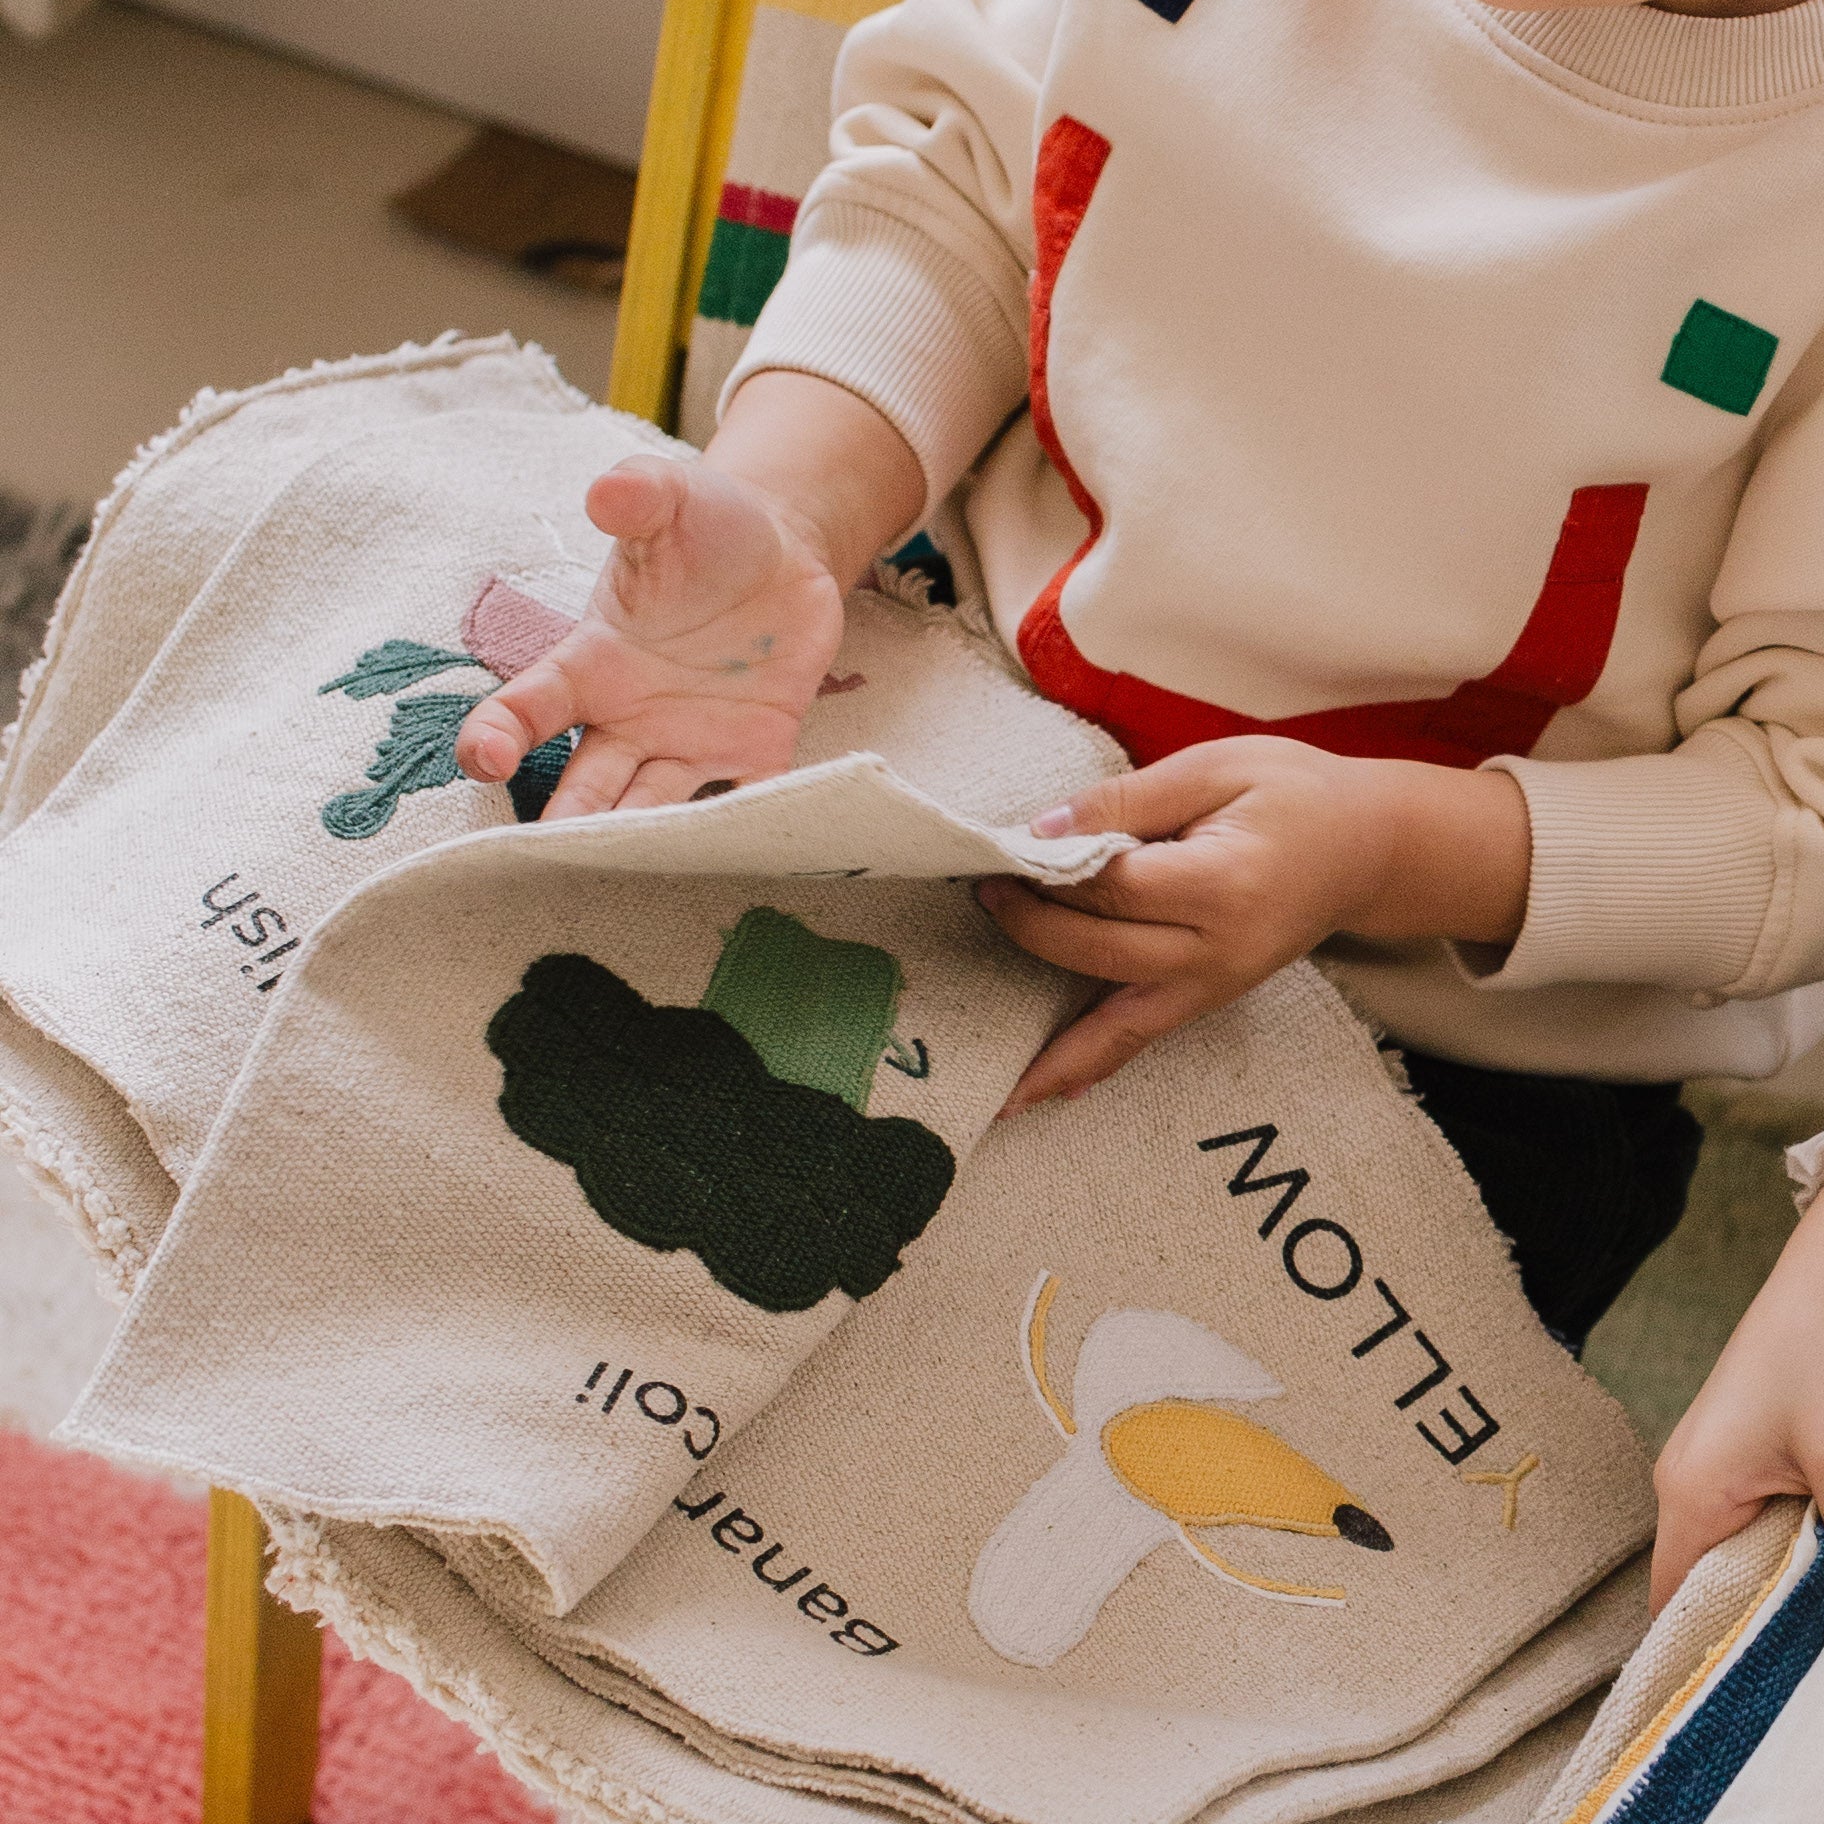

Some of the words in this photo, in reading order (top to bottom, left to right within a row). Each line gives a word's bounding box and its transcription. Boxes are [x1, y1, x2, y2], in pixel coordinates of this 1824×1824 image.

[200, 873, 300, 993] ish
[1197, 1123, 1540, 1532] YELLOW
[574, 1361, 721, 1460] coli
[674, 1491, 901, 1657] Banan
